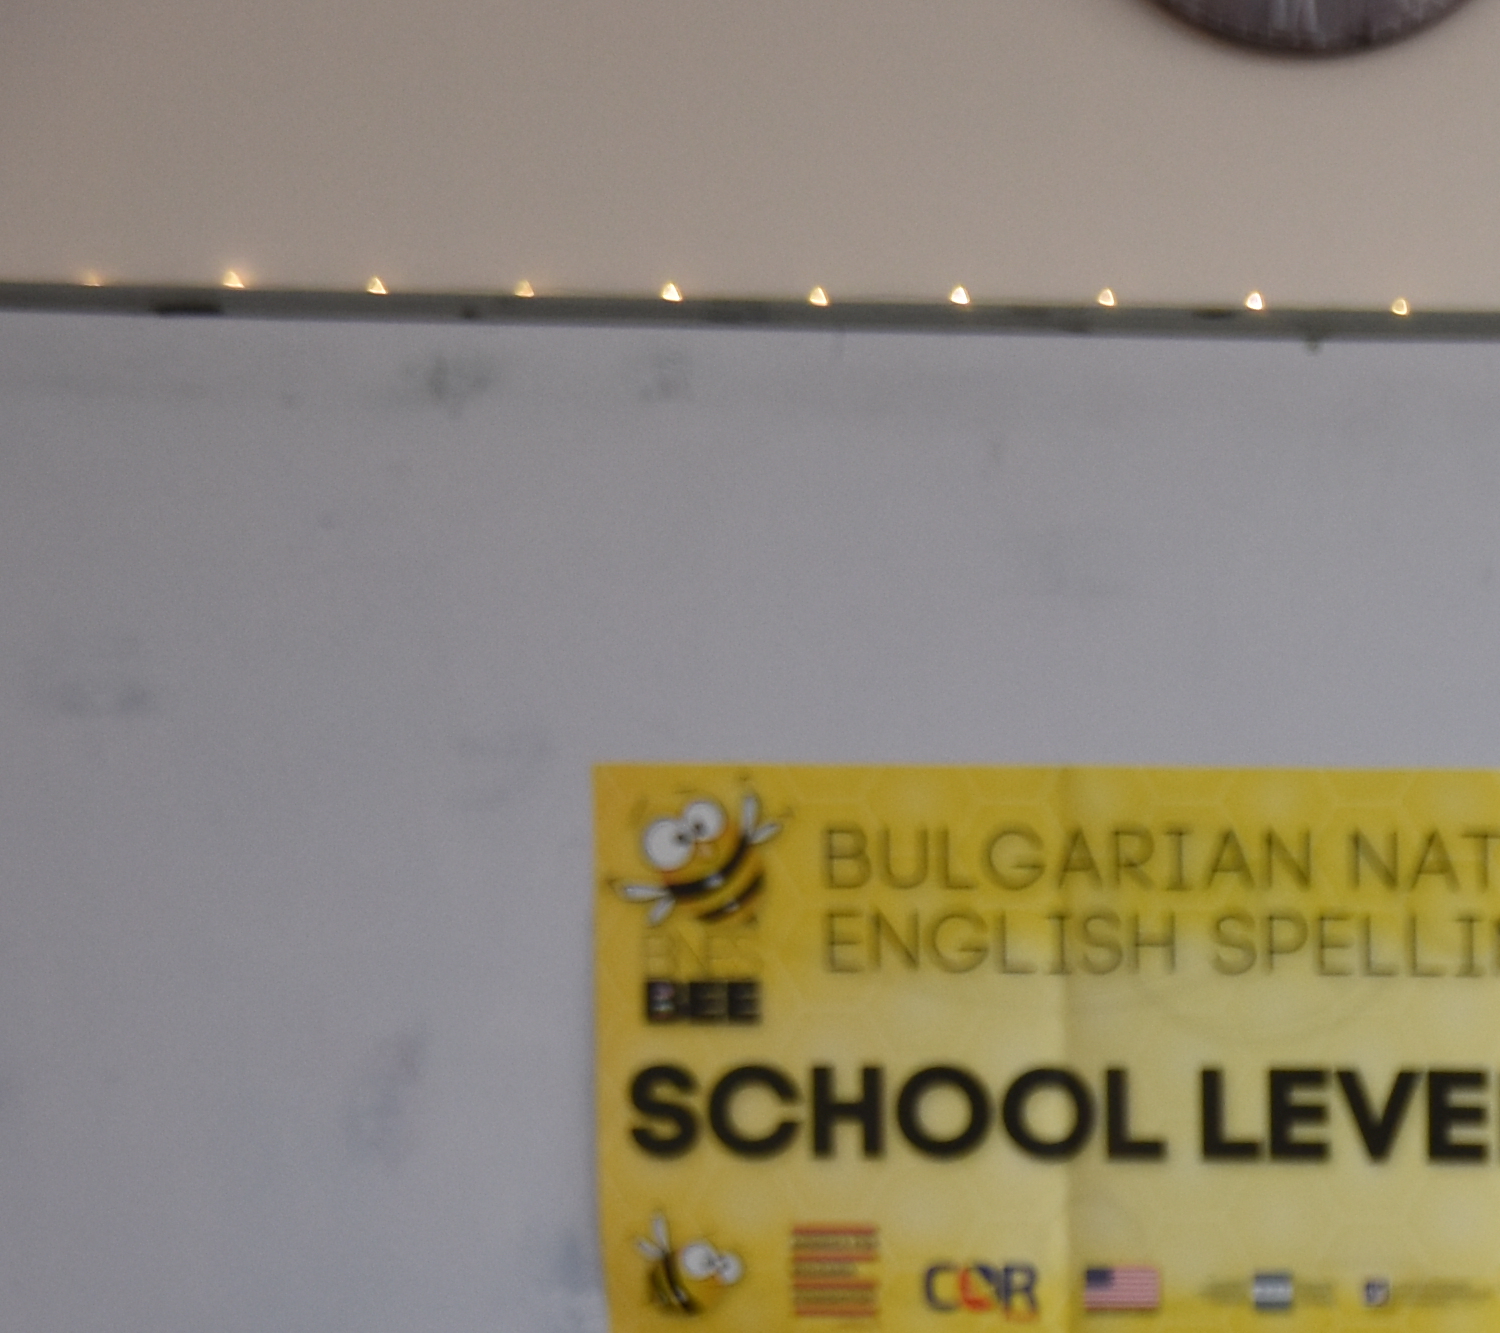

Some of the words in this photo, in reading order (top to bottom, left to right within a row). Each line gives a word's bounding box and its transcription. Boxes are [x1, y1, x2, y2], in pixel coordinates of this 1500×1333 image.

[822, 820, 1312, 892] BULGARIAN
[822, 907, 1177, 977] ENGLISH
[629, 1062, 1168, 1162] SCHOOL
